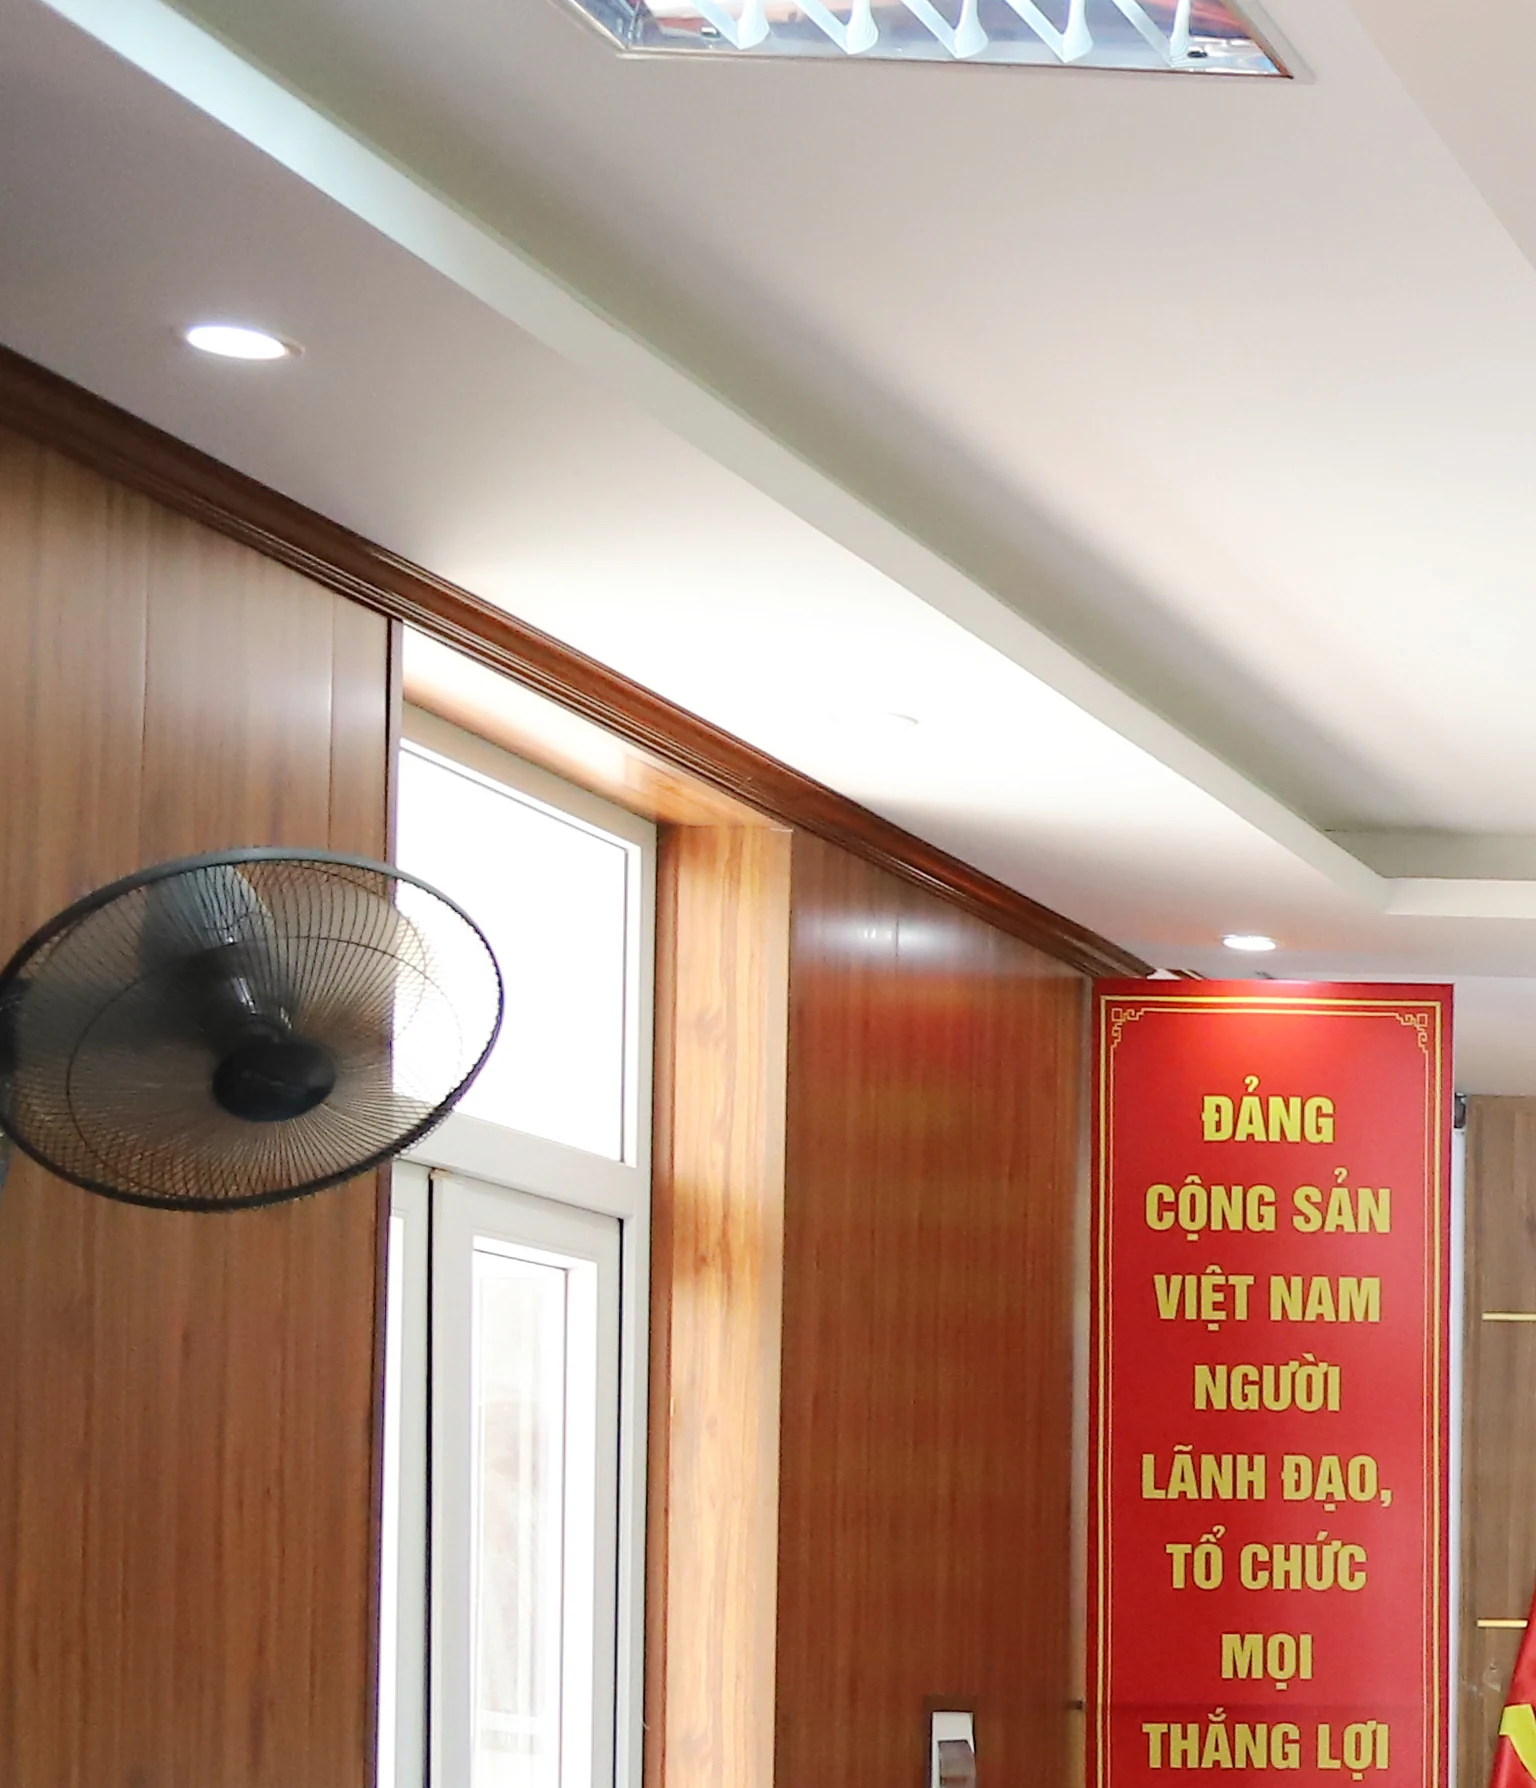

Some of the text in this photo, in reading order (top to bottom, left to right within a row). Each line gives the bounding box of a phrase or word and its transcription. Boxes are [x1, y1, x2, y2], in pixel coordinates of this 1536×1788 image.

[1201, 1075, 1334, 1143] ĐẢNG
[1145, 1167, 1391, 1241] CỘNG SẢN
[1153, 1264, 1380, 1331] VIỆT NAM
[1194, 1352, 1340, 1412] NGƯỜI
[1141, 1444, 1392, 1512] LÃNH ĐẠO,
[1165, 1525, 1367, 1591] TỔ CHỨC
[1221, 1632, 1312, 1690] MỌI
[1141, 1707, 1389, 1781] THẮNG LỢI
